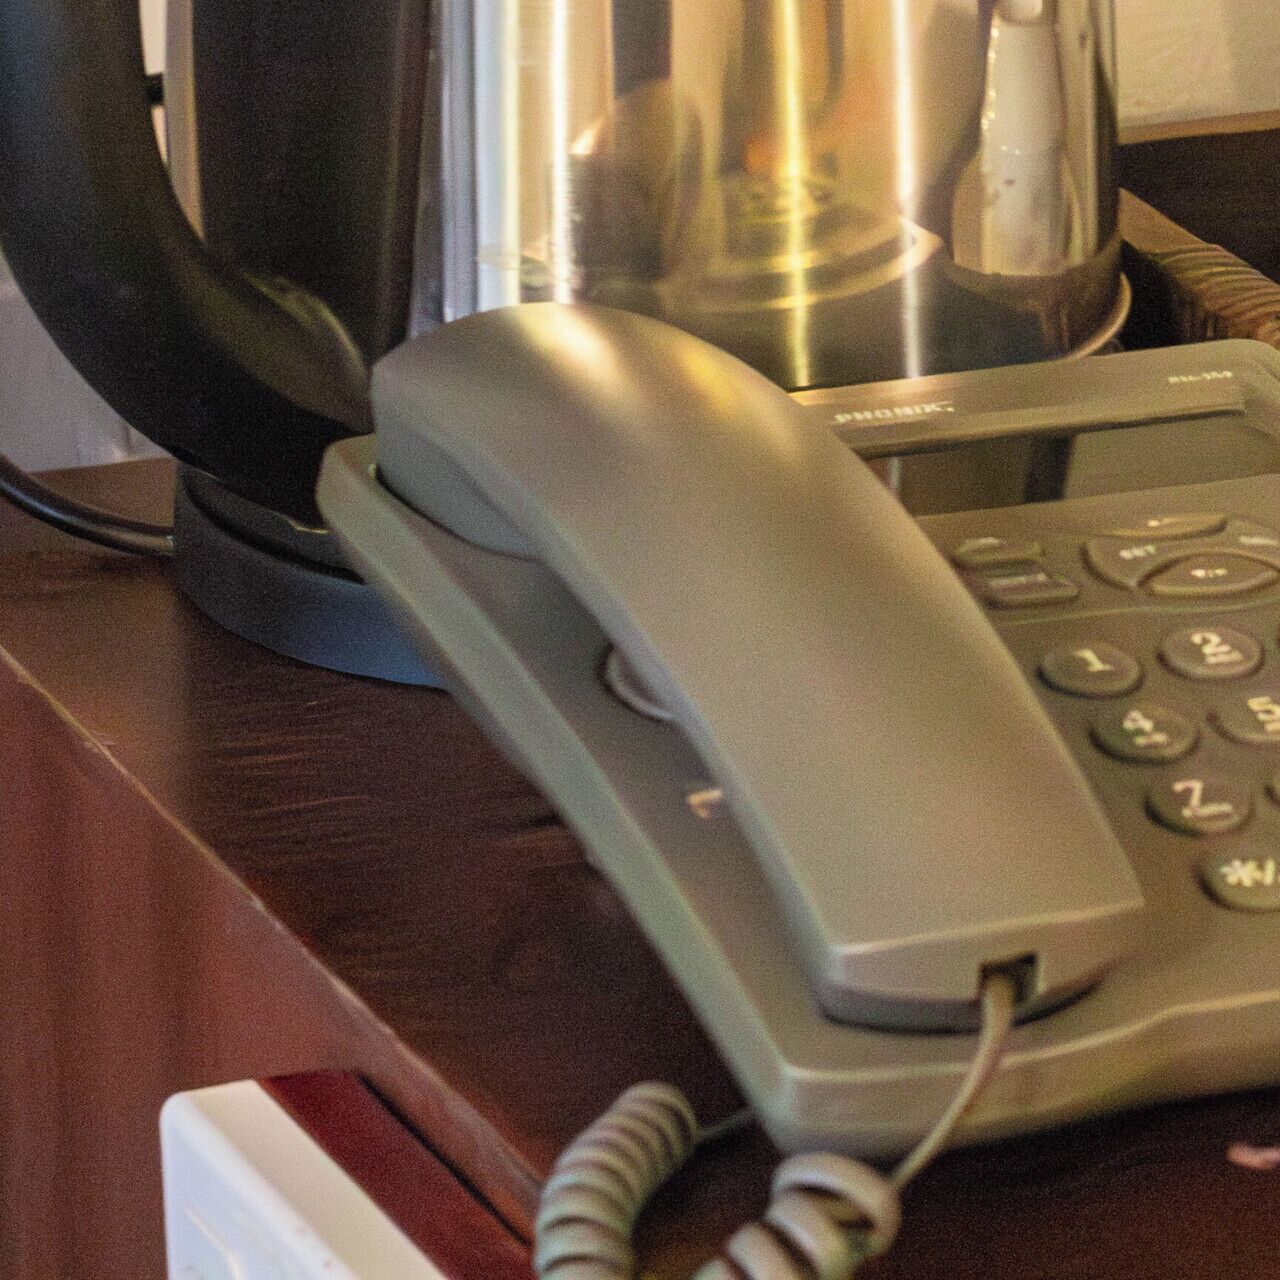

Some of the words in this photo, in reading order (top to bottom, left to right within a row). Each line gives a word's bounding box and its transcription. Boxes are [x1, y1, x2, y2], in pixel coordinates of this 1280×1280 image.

[1190, 631, 1231, 655] 2
[1074, 648, 1114, 672] 1
[1123, 709, 1154, 732] 4
[1172, 780, 1204, 812] 7
